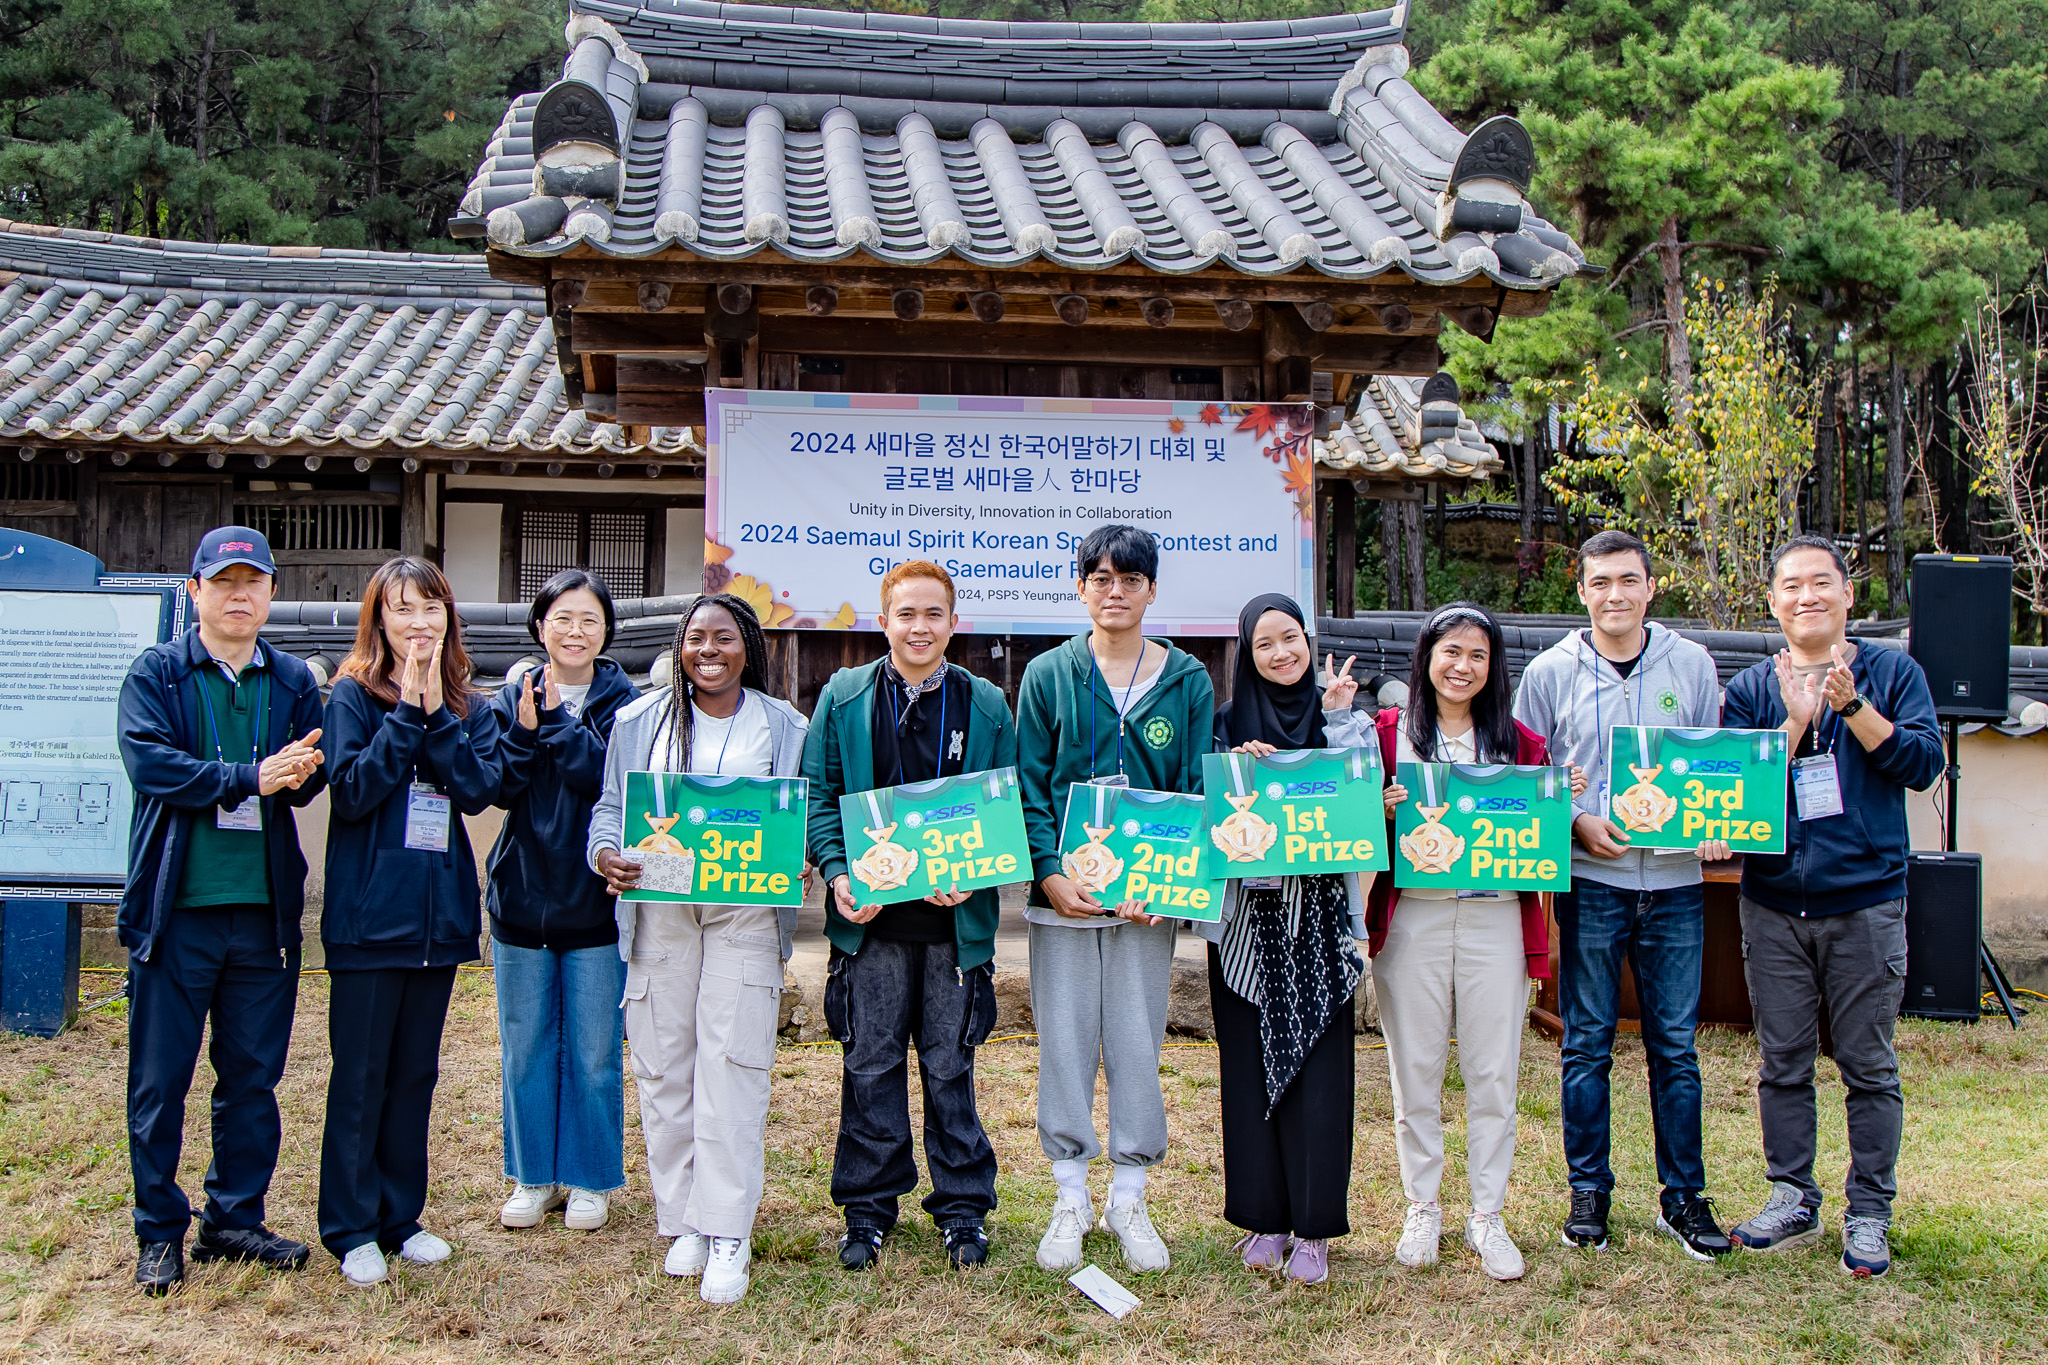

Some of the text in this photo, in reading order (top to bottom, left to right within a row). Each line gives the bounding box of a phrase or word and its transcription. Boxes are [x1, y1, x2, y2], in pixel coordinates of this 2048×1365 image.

[790, 431, 1226, 462] 2024 새마을 정신 한국어말하기 대회 및
[883, 466, 954, 491] 글로벌
[1070, 468, 1141, 493] 한마당
[849, 502, 1172, 520] Unity in Diversity, Innovation in Collaboration
[218, 541, 254, 554] PSPS
[740, 523, 799, 544] 2024
[806, 525, 901, 547] Saemaul
[908, 529, 965, 552] Spirit
[972, 530, 1049, 550] Korean
[1238, 533, 1278, 551] and
[945, 558, 1063, 579] Saemauler
[957, 589, 984, 602] 024,
[988, 589, 1019, 600] PSPS
[6, 639, 30, 647] dispense
[73, 641, 93, 649] special
[118, 642, 137, 650] typical
[66, 651, 97, 659] residential
[85, 684, 105, 692] simple
[34, 751, 57, 759] House
[82, 752, 108, 760] Gabled
[1689, 759, 1742, 773] PSPS
[1285, 781, 1337, 795] PSPS
[1682, 779, 1744, 810] 3rd
[924, 802, 976, 822] PSPS
[1476, 797, 1528, 811] PSPS
[1637, 799, 1651, 817] 3
[707, 807, 762, 822] PSPS
[1282, 804, 1327, 833] 1st
[1140, 822, 1192, 839] PSPS
[1471, 817, 1540, 849] 2nd
[1682, 809, 1772, 842] Prize
[699, 829, 763, 862] 3rd
[922, 819, 984, 857] 3rd
[1238, 827, 1248, 847] 1
[1284, 831, 1375, 863] Prize
[1426, 838, 1440, 857] 2
[880, 857, 894, 875] 3
[925, 850, 1018, 886] Prize
[1085, 858, 1099, 877] 2
[1129, 842, 1201, 877] 2nd
[1470, 848, 1559, 881] Prize
[699, 861, 790, 894] Prize
[1124, 871, 1211, 909] Prize
